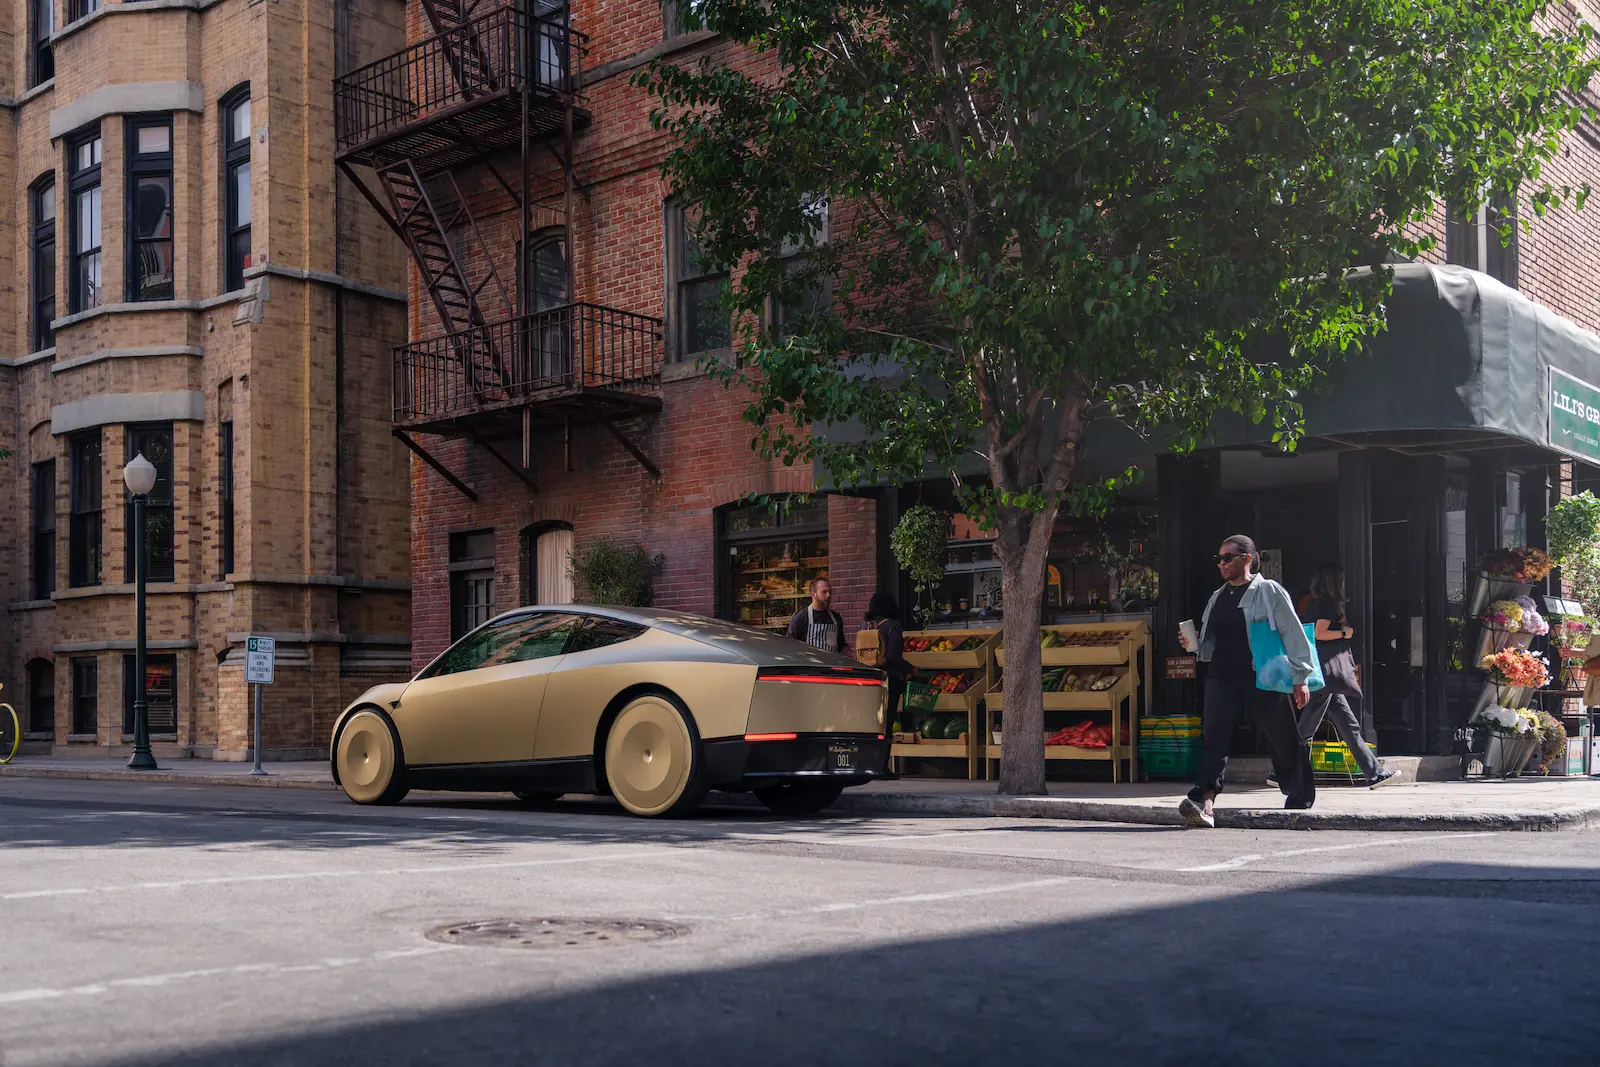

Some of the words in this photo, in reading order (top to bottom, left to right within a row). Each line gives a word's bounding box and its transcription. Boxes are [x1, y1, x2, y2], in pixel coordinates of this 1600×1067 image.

[1553, 390, 1585, 418] LILI'S
[249, 639, 257, 650] 15
[837, 754, 850, 767] 001
